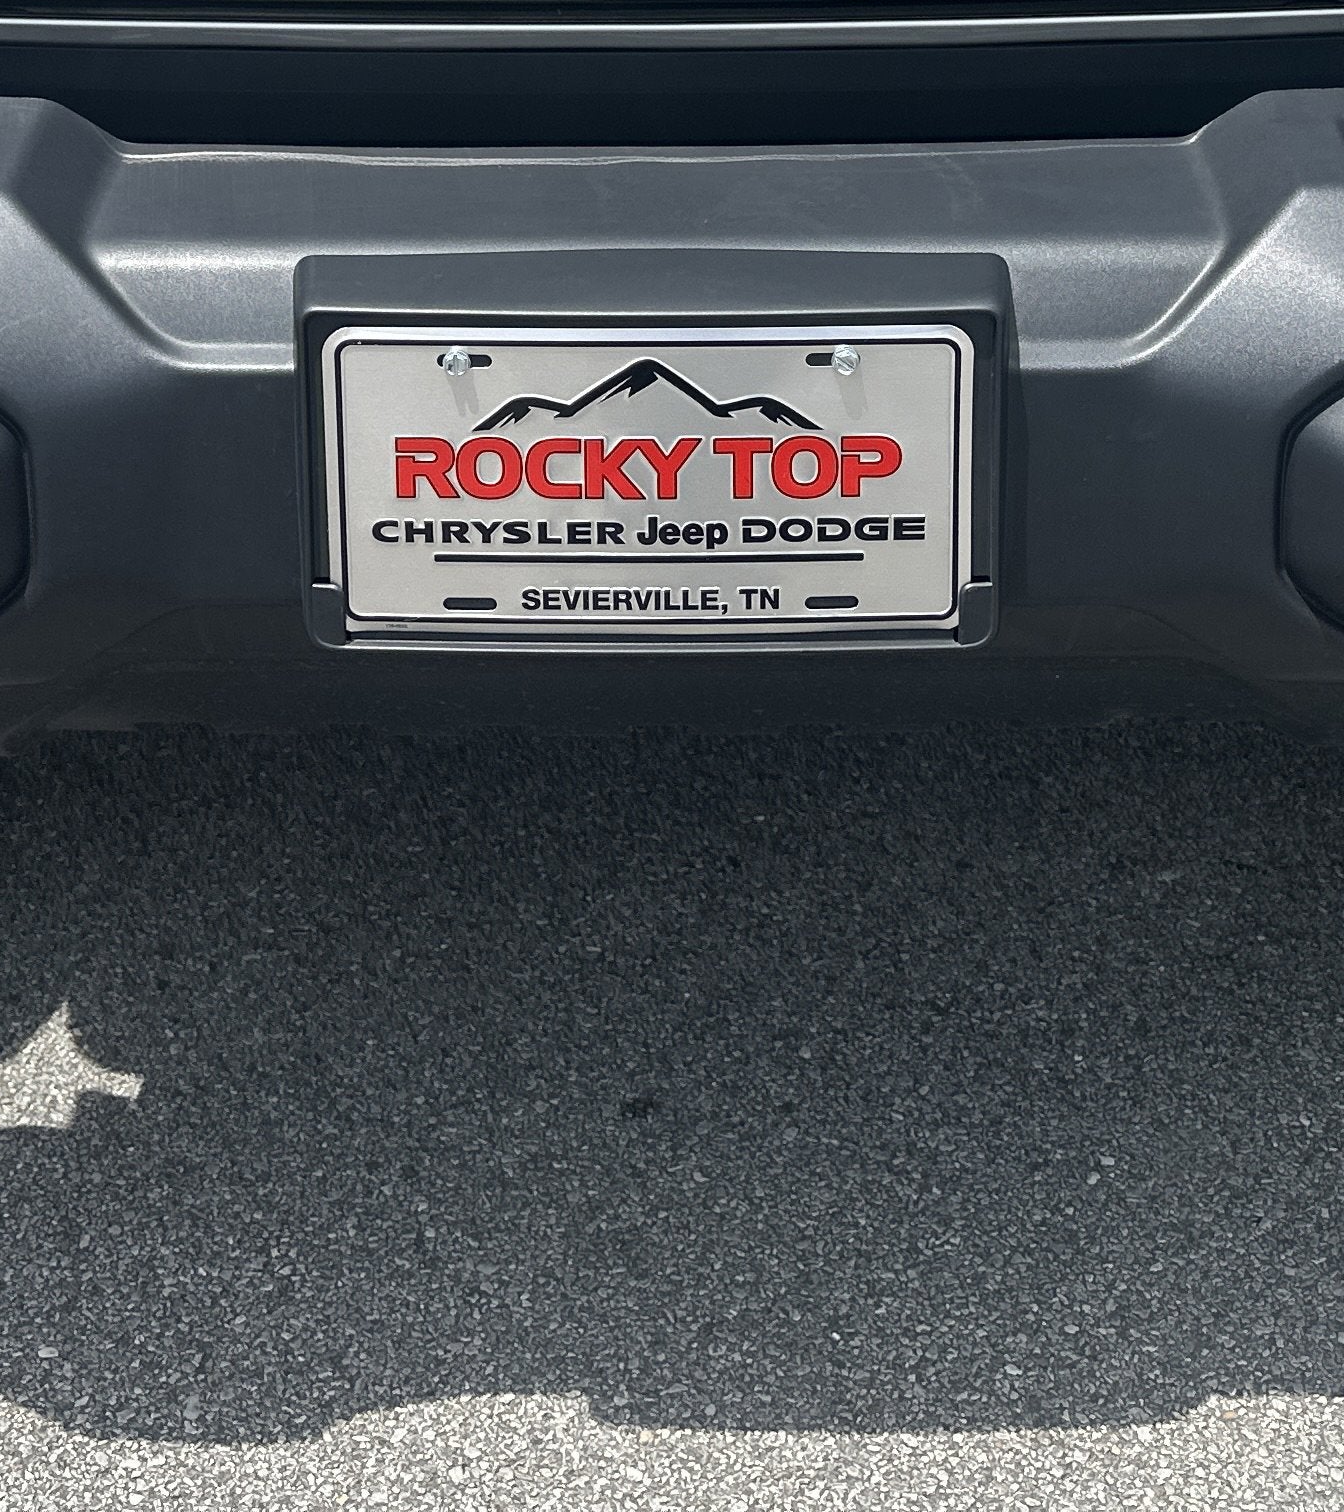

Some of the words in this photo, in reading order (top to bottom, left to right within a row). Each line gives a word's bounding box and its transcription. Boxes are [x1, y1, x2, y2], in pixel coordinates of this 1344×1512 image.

[394, 436, 701, 500] ROCKY
[713, 435, 903, 500] TOP
[371, 520, 625, 545] CHRYSLER
[636, 516, 728, 549] Jeep
[742, 516, 926, 543] DODGE
[521, 588, 728, 615] SEVIERVILLE,
[739, 588, 780, 610] TN
